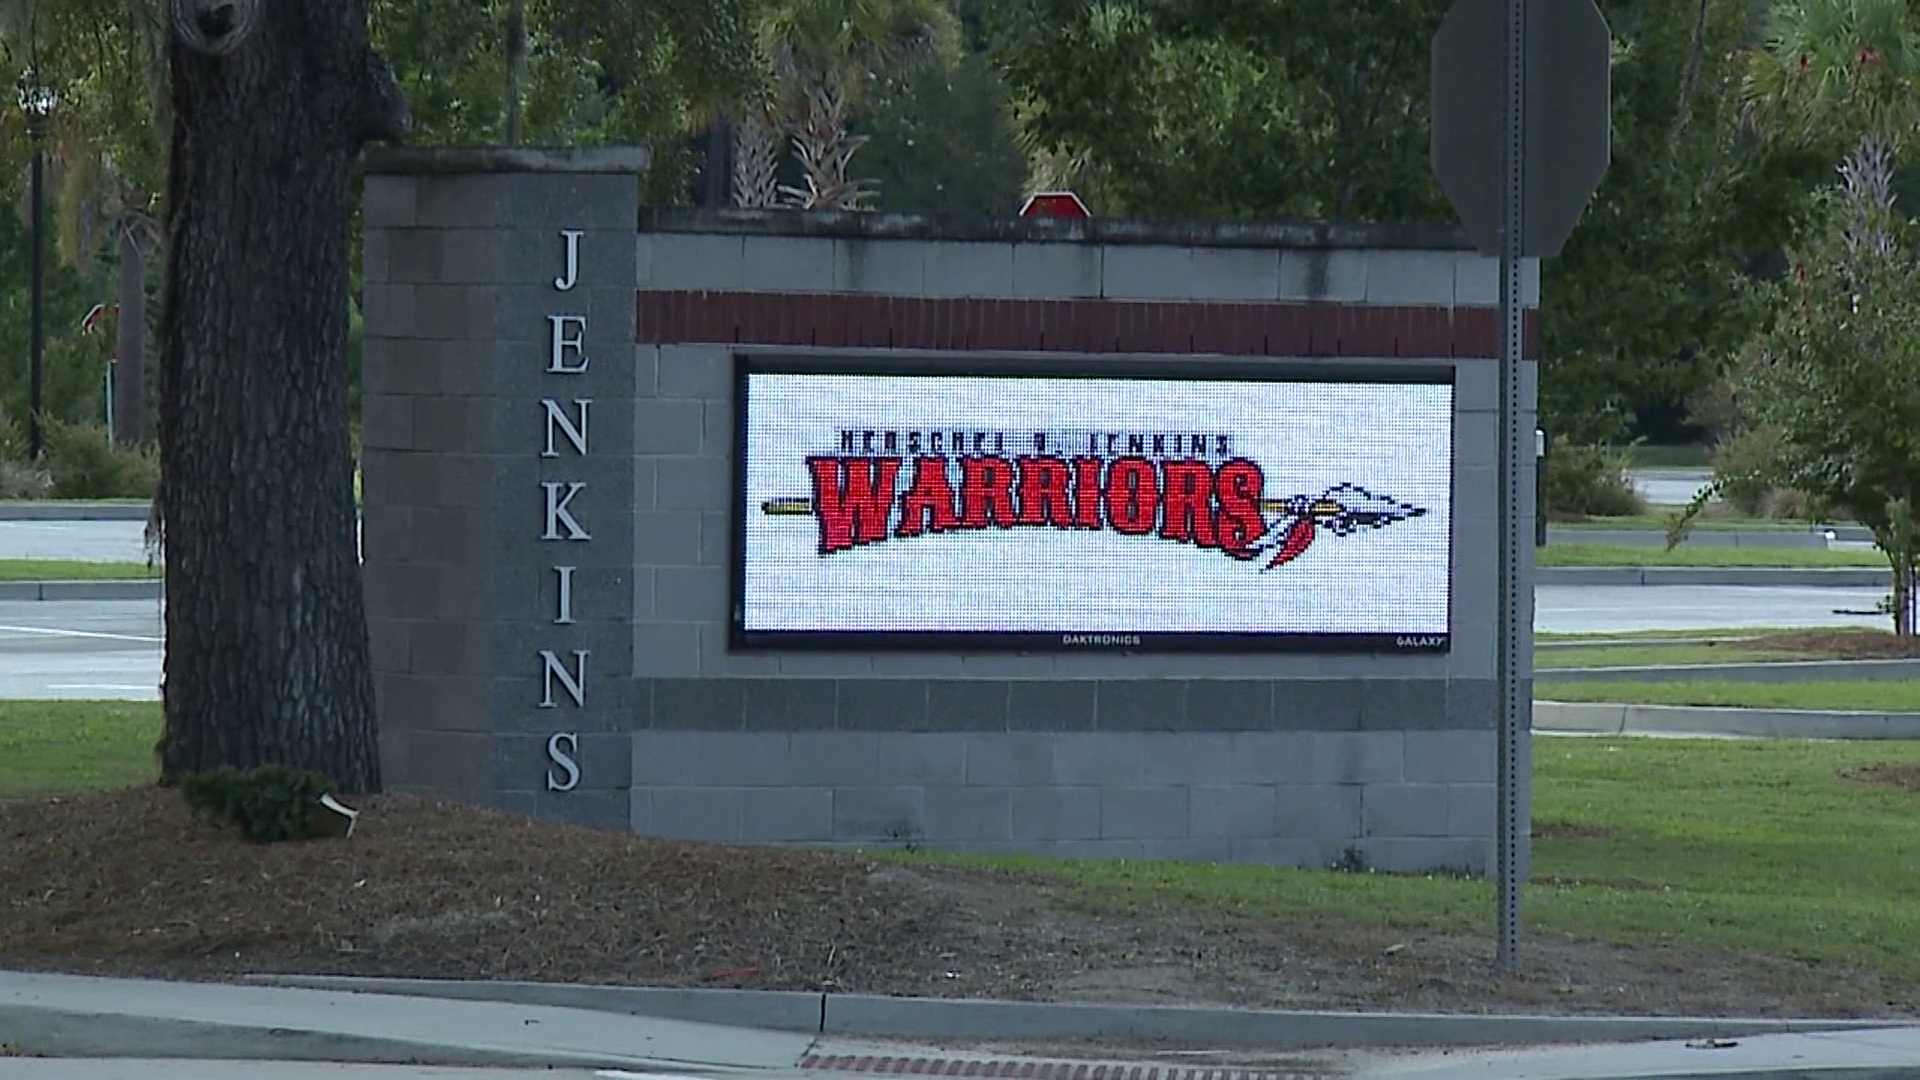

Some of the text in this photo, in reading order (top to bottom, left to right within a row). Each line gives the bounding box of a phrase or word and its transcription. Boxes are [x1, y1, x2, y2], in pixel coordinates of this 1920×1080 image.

[538, 230, 592, 792] JENKINS
[806, 455, 1265, 560] WARRIORS
[1062, 634, 1141, 646] DAKTRONICS
[1396, 636, 1446, 647] GALAXY
